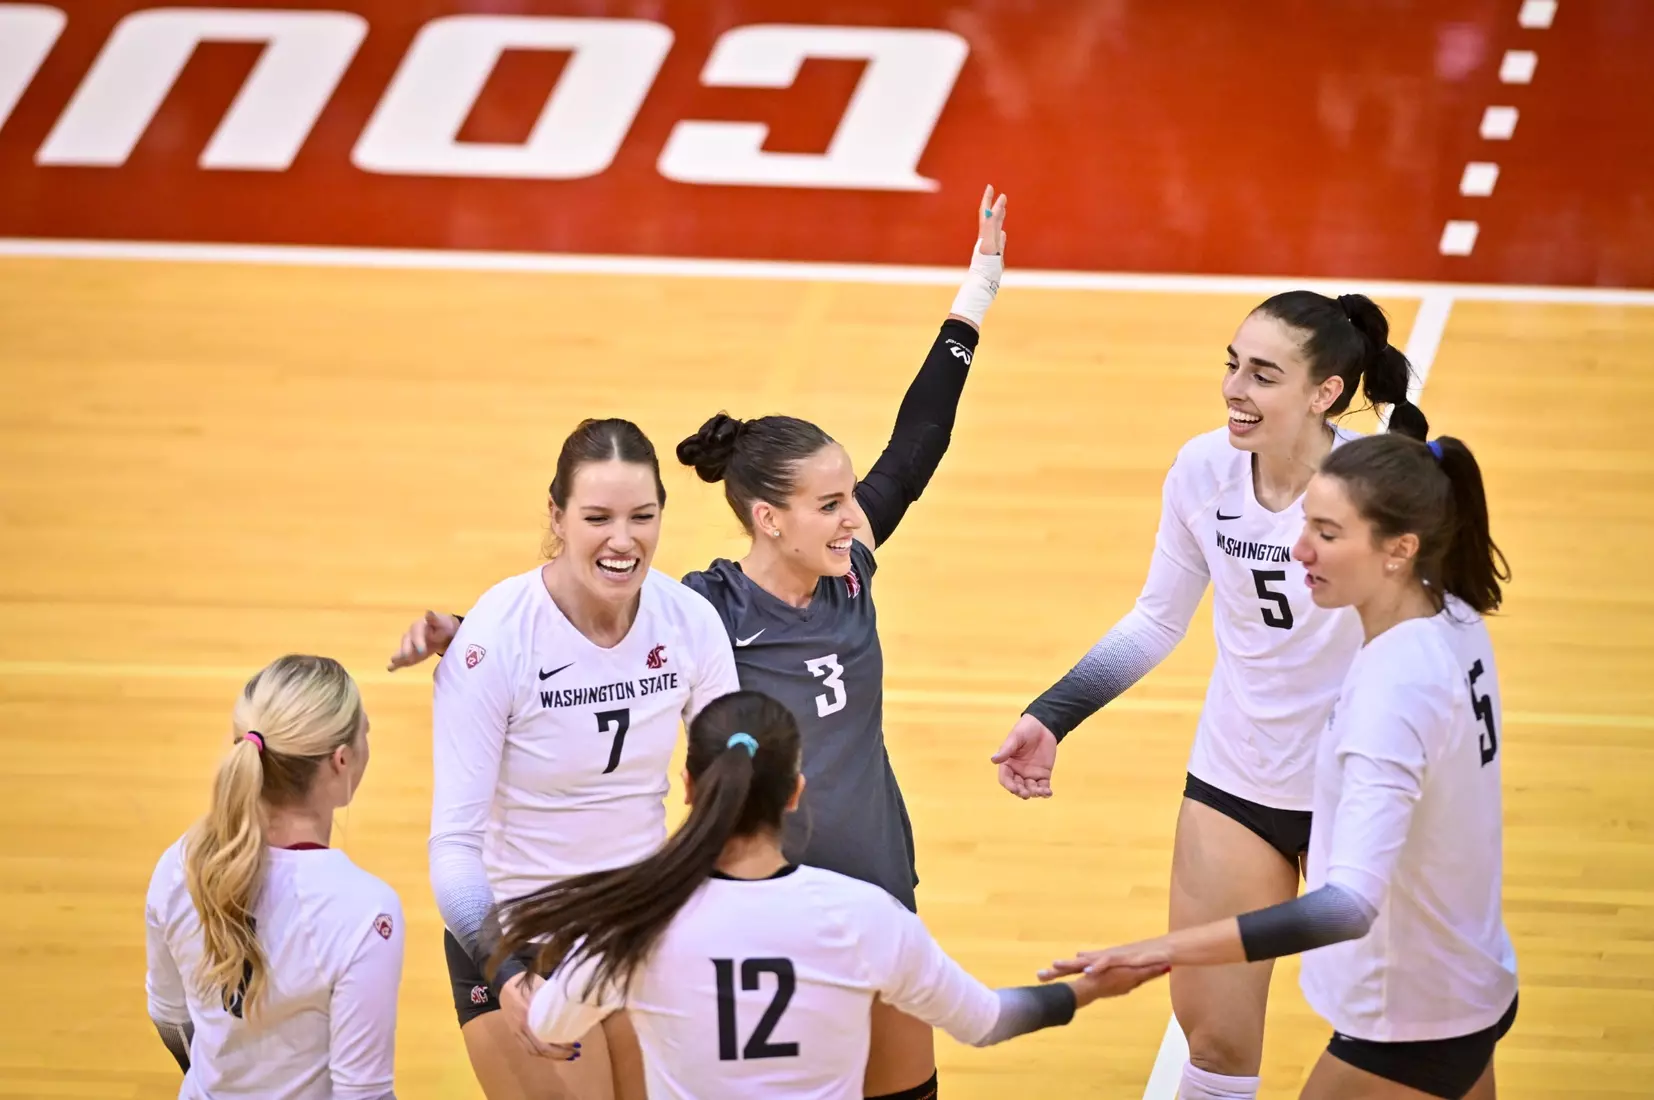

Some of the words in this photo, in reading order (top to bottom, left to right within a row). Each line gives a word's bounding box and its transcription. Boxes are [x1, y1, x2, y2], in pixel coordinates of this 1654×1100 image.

[1250, 569, 1294, 630] 5
[540, 681, 635, 708] WASHINGTON
[639, 673, 678, 696] STATE
[803, 653, 847, 718] 3
[1468, 658, 1497, 768] 5
[593, 708, 630, 774] 7
[708, 957, 799, 1061] 12
